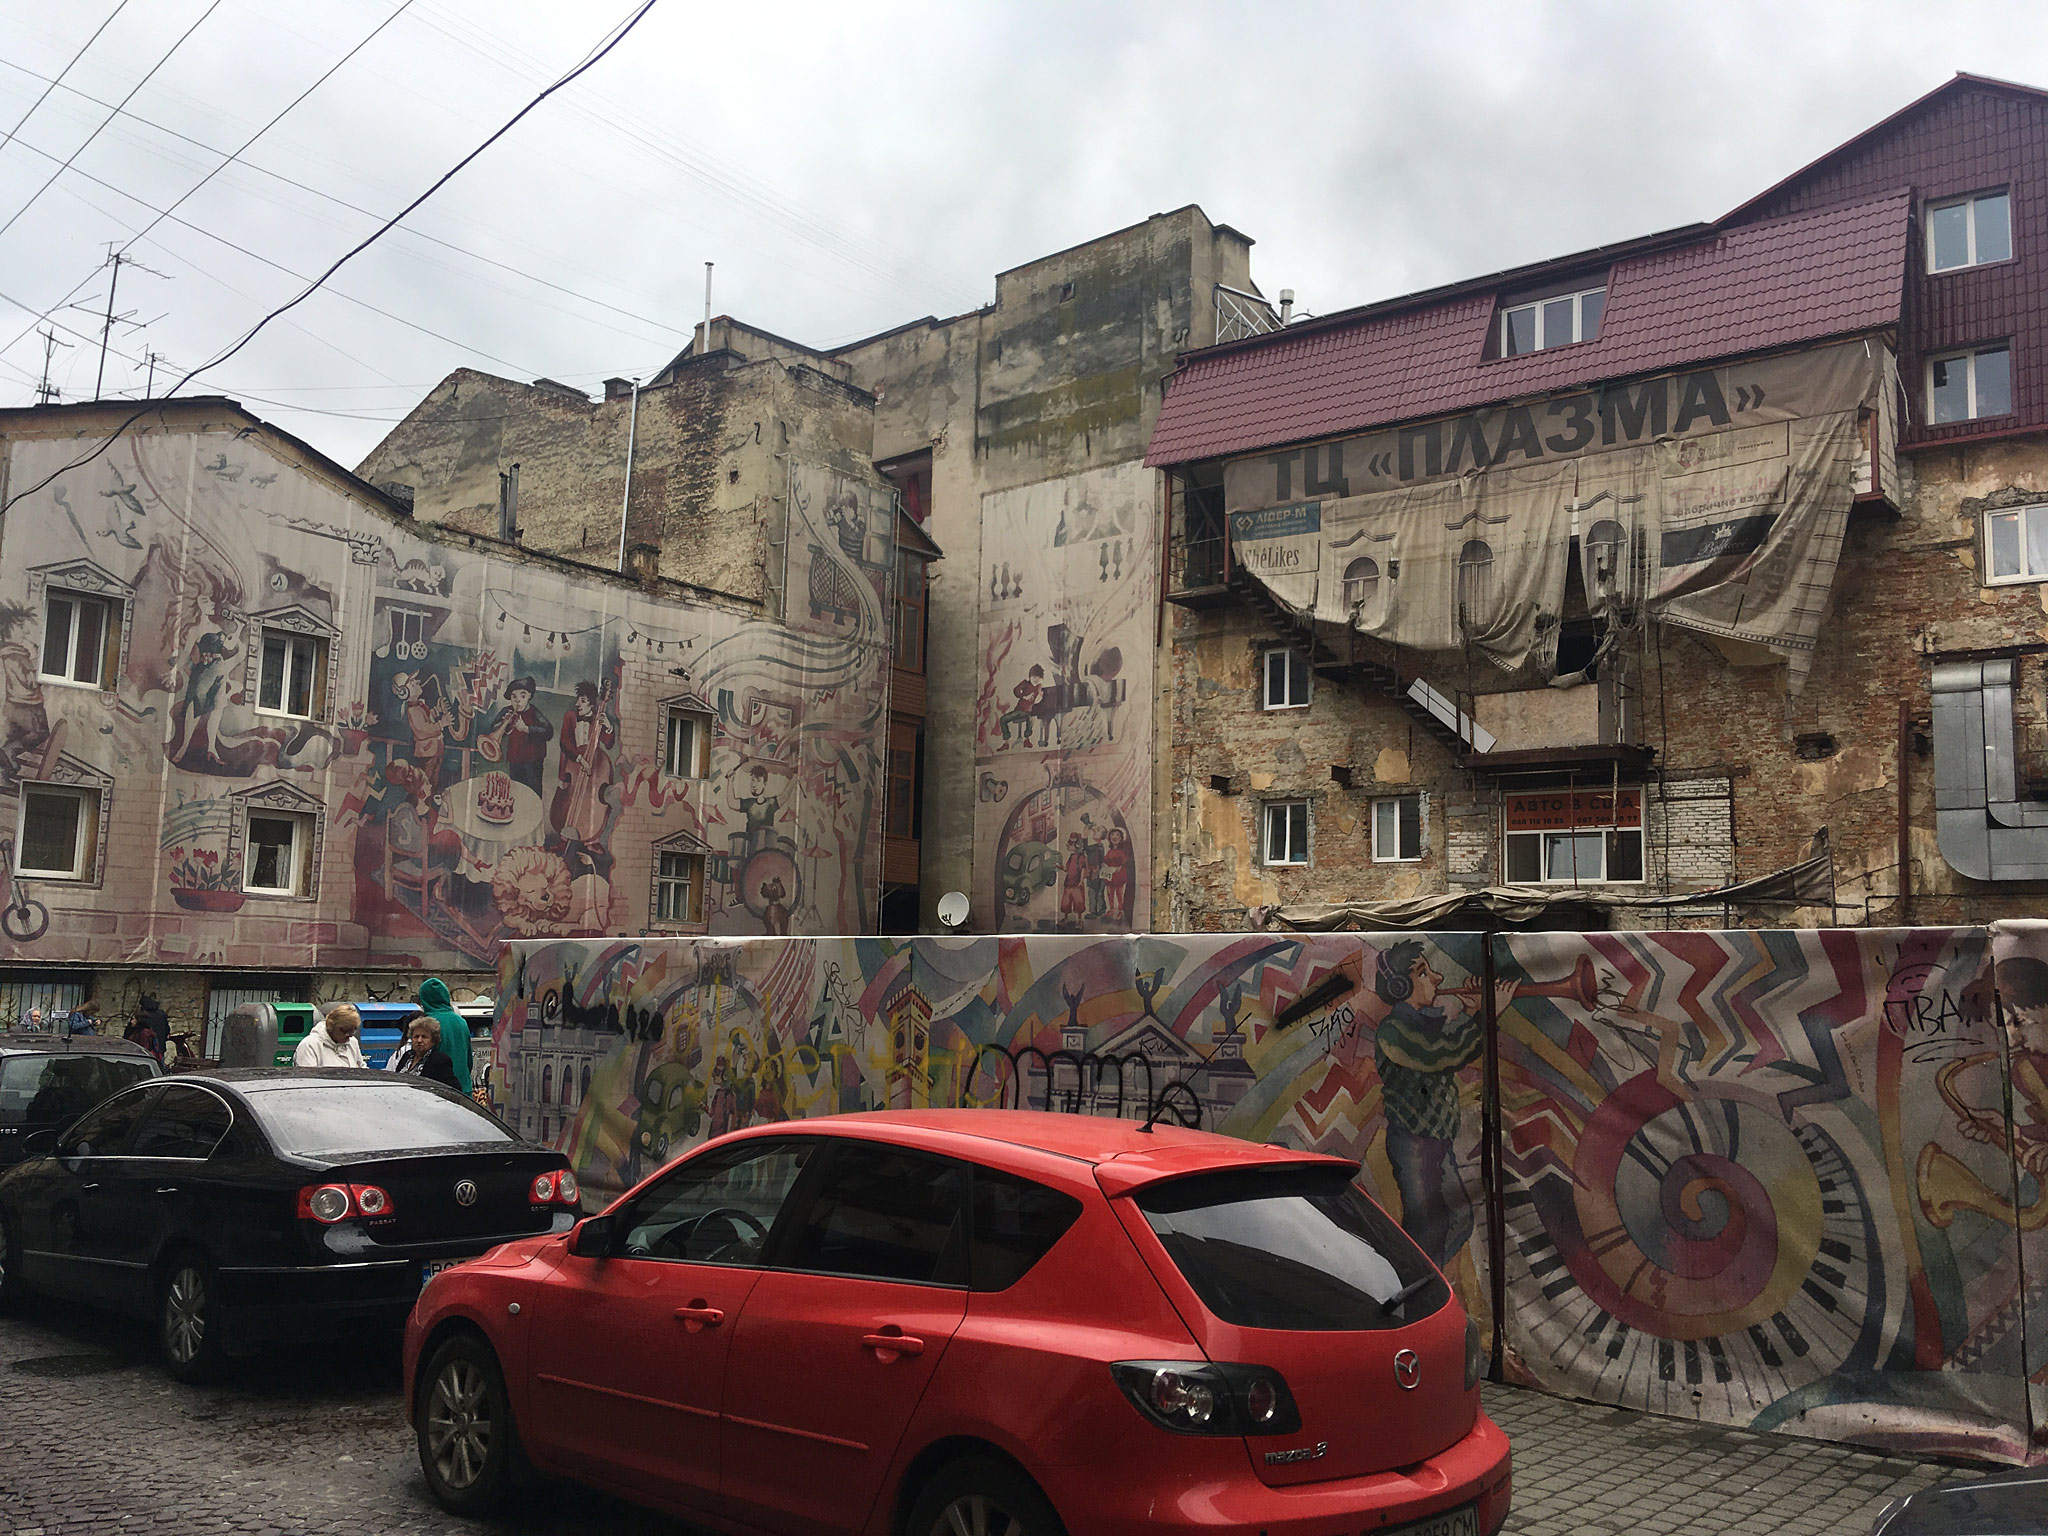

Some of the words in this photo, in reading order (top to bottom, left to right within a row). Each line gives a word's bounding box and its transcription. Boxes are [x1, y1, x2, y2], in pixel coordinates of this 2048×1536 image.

[1267, 440, 1350, 501] ТЦ
[1367, 368, 1767, 478] «ПЛАЗМА»
[1255, 506, 1307, 524] ЛІДЕР-М
[1513, 799, 1563, 812] АВТО
